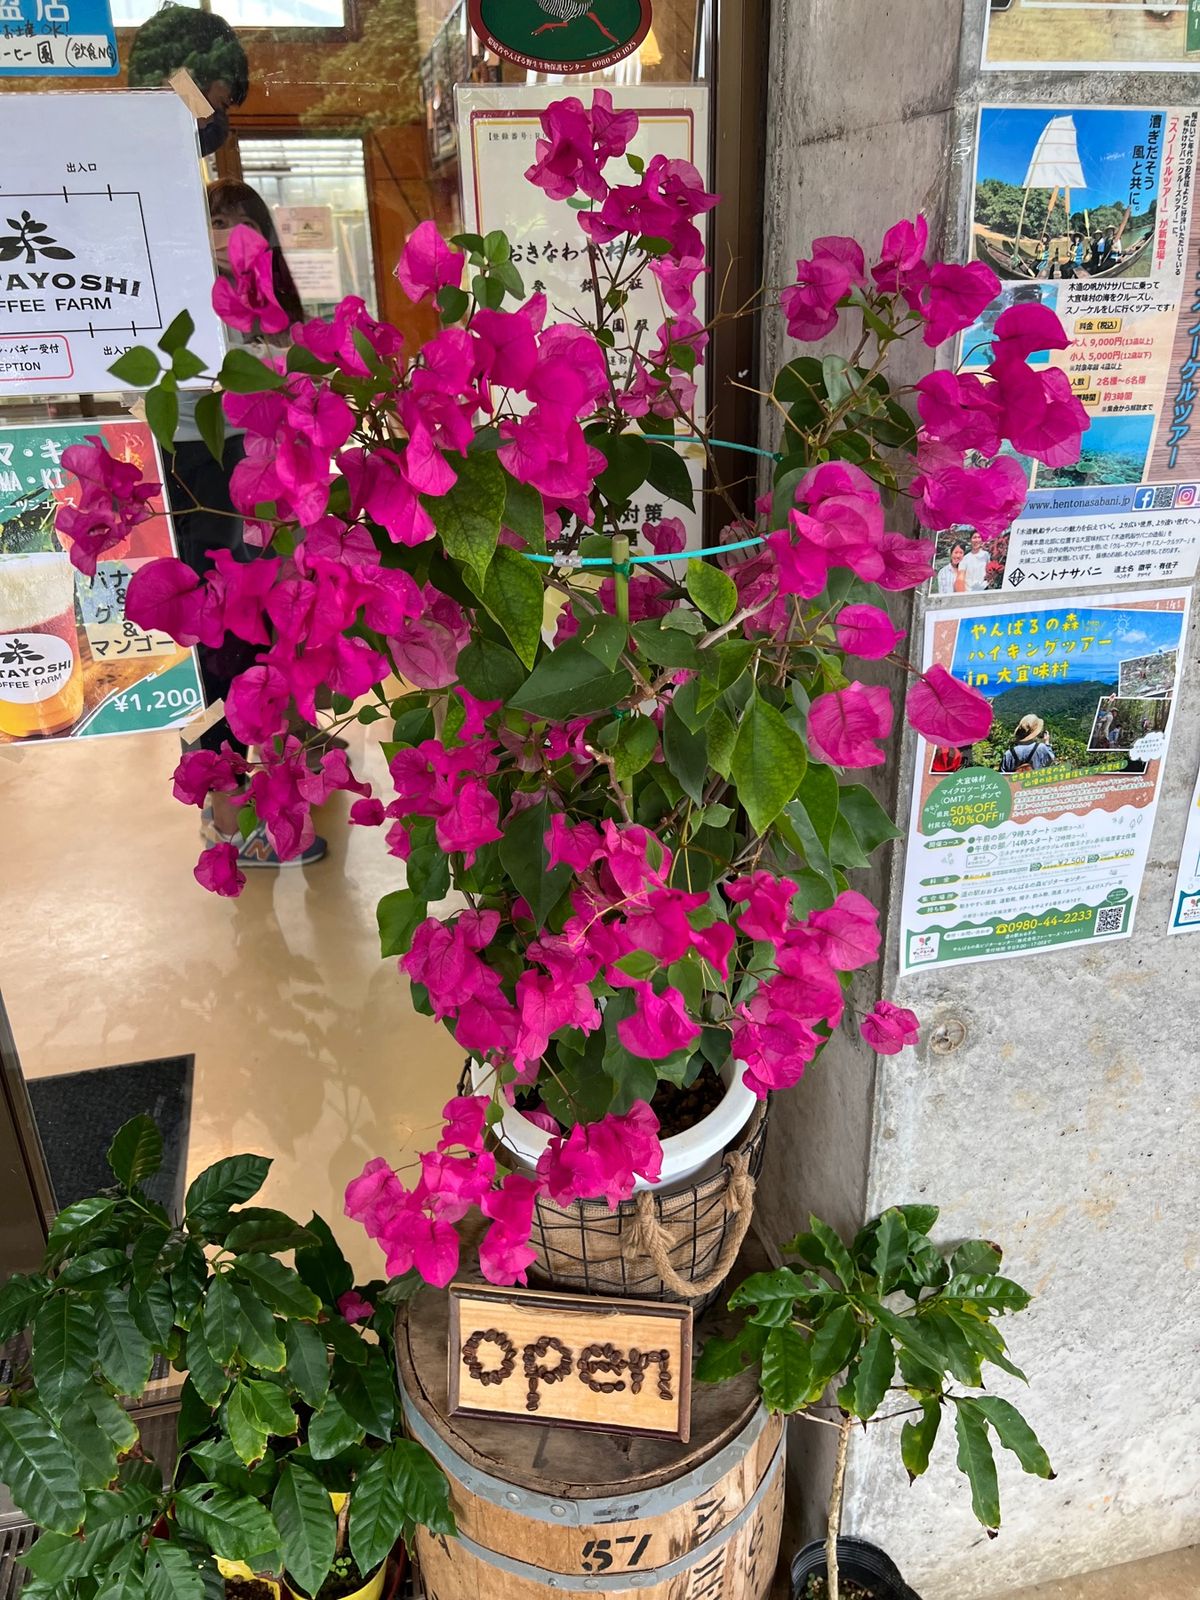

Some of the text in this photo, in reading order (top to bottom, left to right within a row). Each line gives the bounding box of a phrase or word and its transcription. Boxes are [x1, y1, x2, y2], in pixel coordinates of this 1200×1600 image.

[1143, 114, 1162, 191] 漕ぎだそう
[66, 162, 97, 174] 出入口
[1128, 145, 1146, 211] 風と共に。
[0, 271, 141, 297] AYOSHI
[1068, 281, 1160, 291] 木造の帆かけサバニに乗って
[56, 297, 111, 312] FARM
[1067, 292, 1154, 303] 大宜味村の海をクルーズし、
[1065, 303, 1175, 314] スノーケルをしに行くツアーです！
[1072, 338, 1087, 347] 大人
[1070, 353, 1085, 362] 小人
[1103, 392, 1133, 401] 約3時間
[1027, 567, 1102, 581] ヘントナサバニ
[123, 622, 139, 637] &
[971, 612, 1080, 639] やんばるの森
[91, 634, 174, 656] マンゴー
[968, 636, 1112, 662] ハイキングツアー
[34, 673, 62, 687] FARM
[966, 661, 1069, 686] in 大宜味村
[114, 687, 197, 713] ¥1,200
[955, 775, 986, 786] 大宜味村
[940, 783, 999, 795] マイクロツーリズム
[1008, 909, 1093, 933] 0980-44-2233
[462, 1328, 673, 1412] open
[580, 1533, 652, 1571] 57
